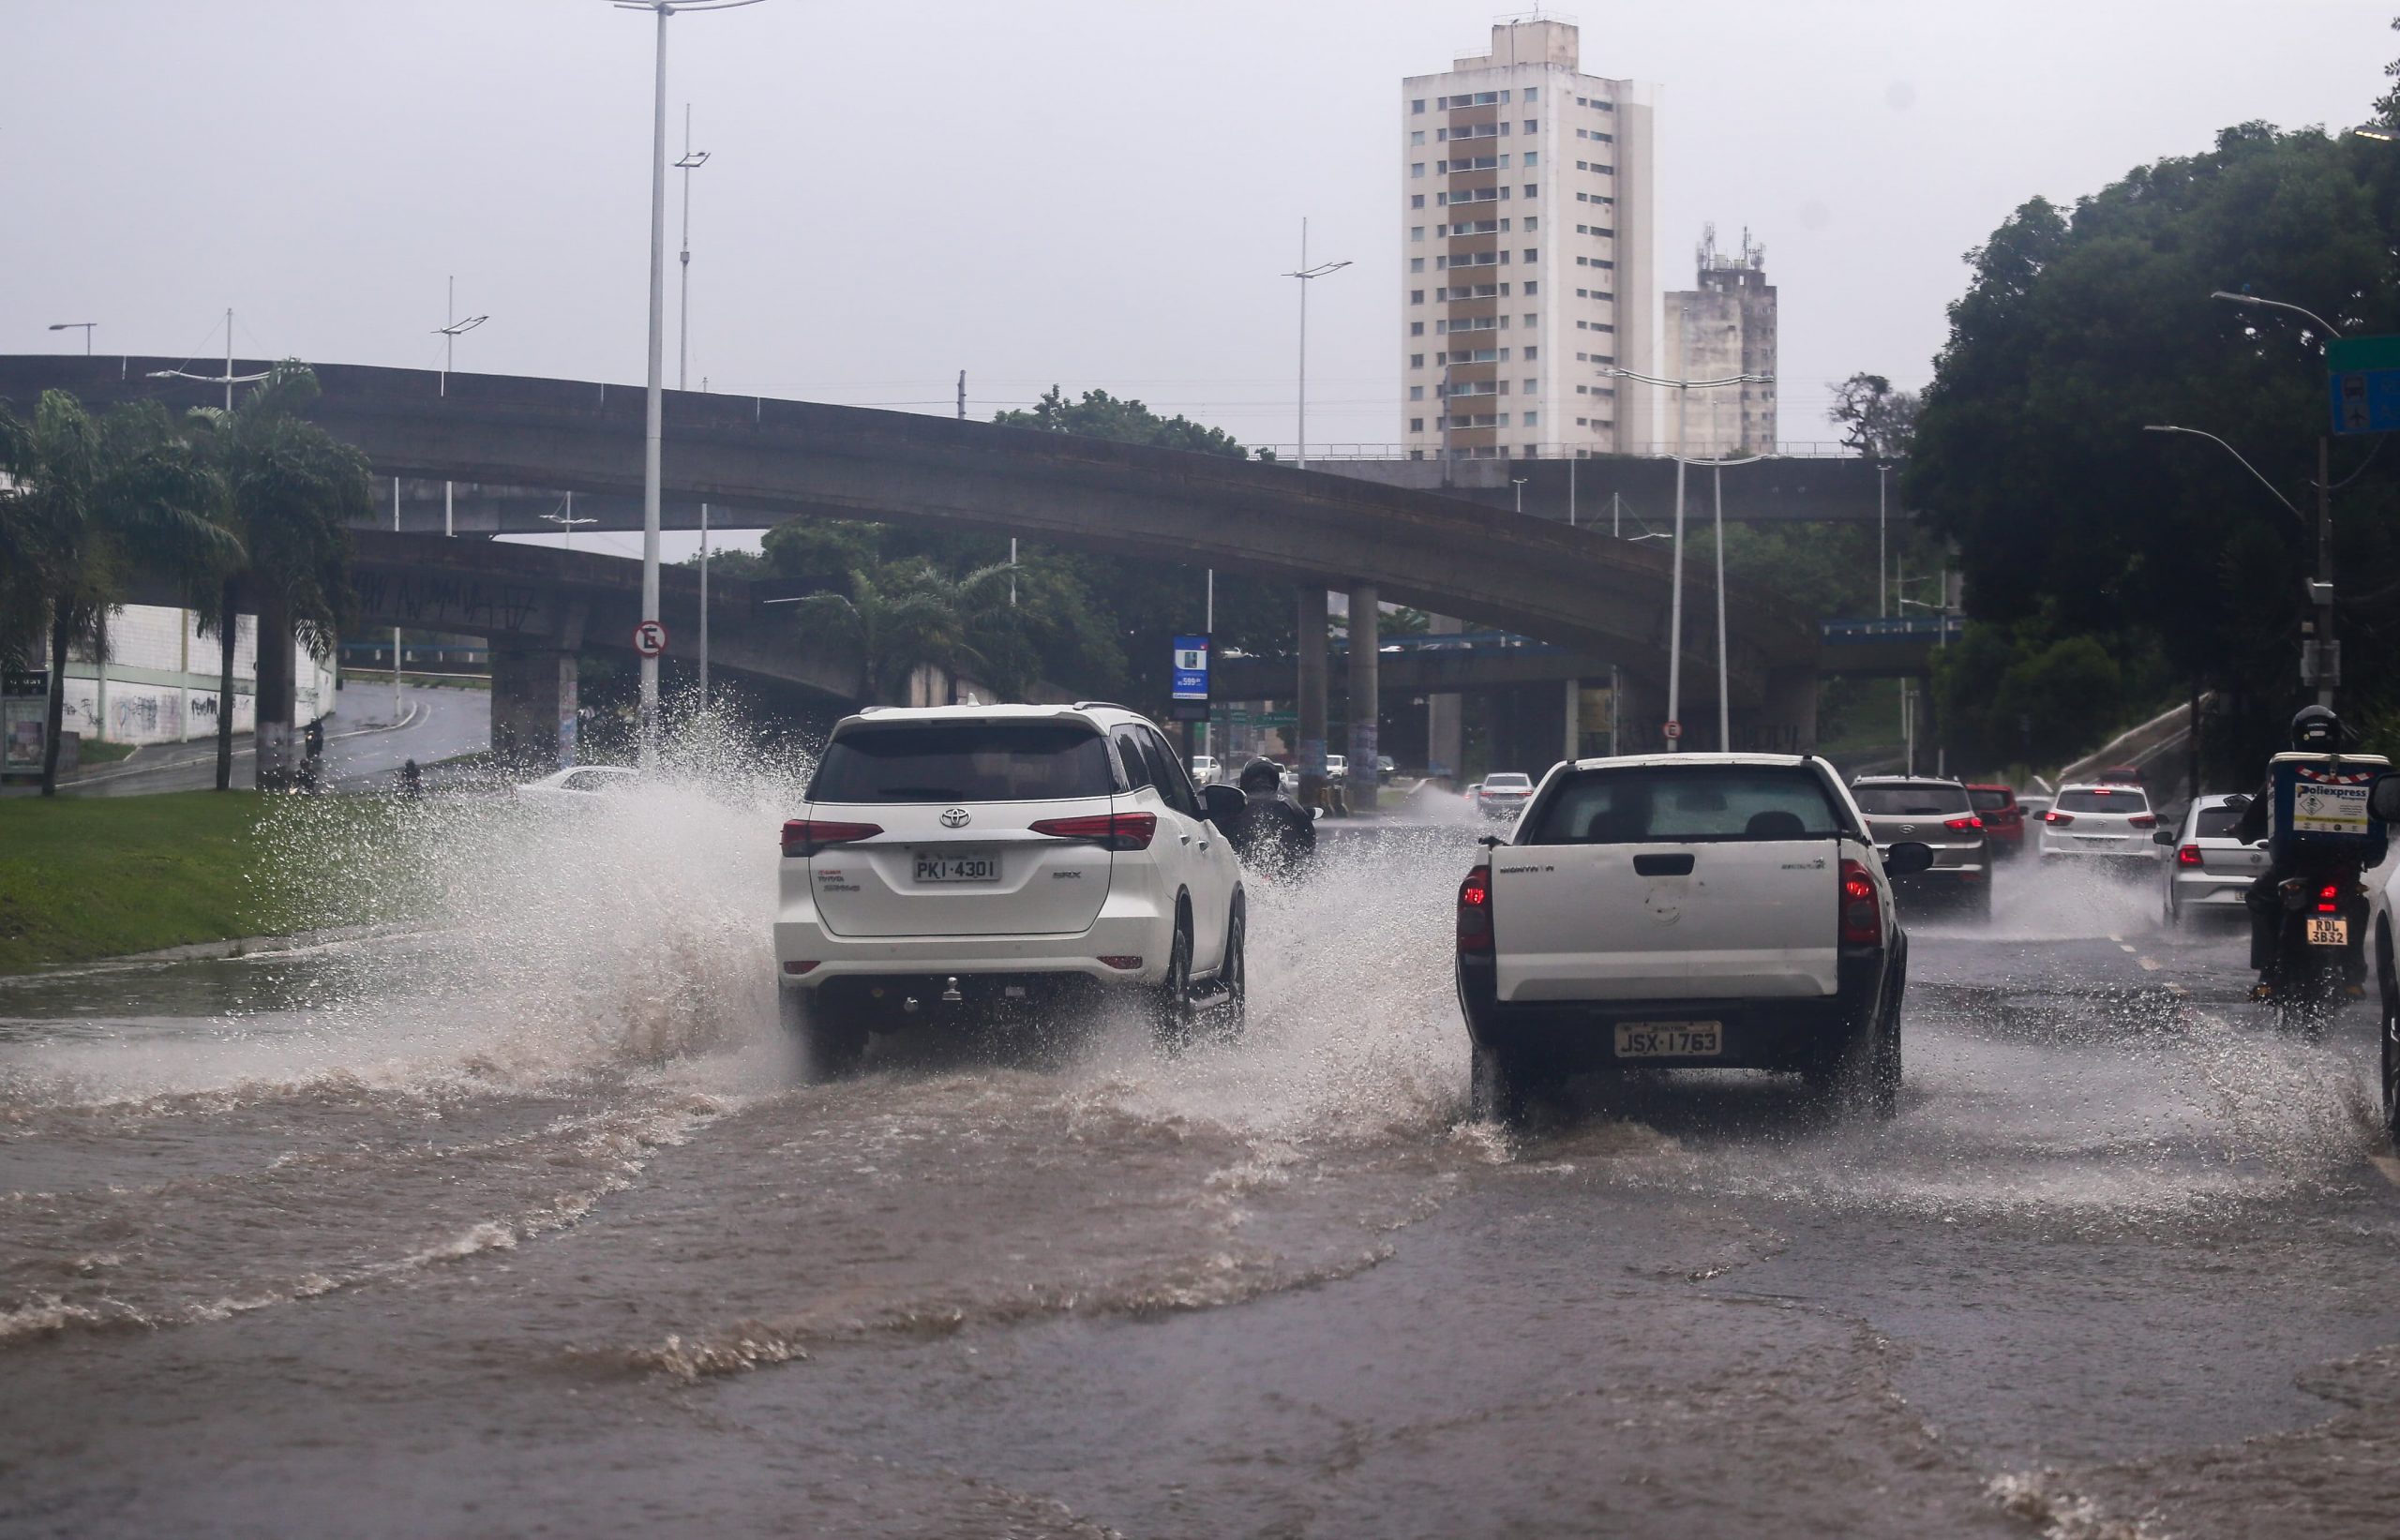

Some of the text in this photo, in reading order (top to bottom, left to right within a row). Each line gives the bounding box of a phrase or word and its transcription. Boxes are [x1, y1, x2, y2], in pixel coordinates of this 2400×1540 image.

[644, 627, 657, 649] E
[2296, 785, 2367, 798] Poliexpress
[2316, 920, 2339, 932] RDL
[2313, 931, 2344, 943] 3B32
